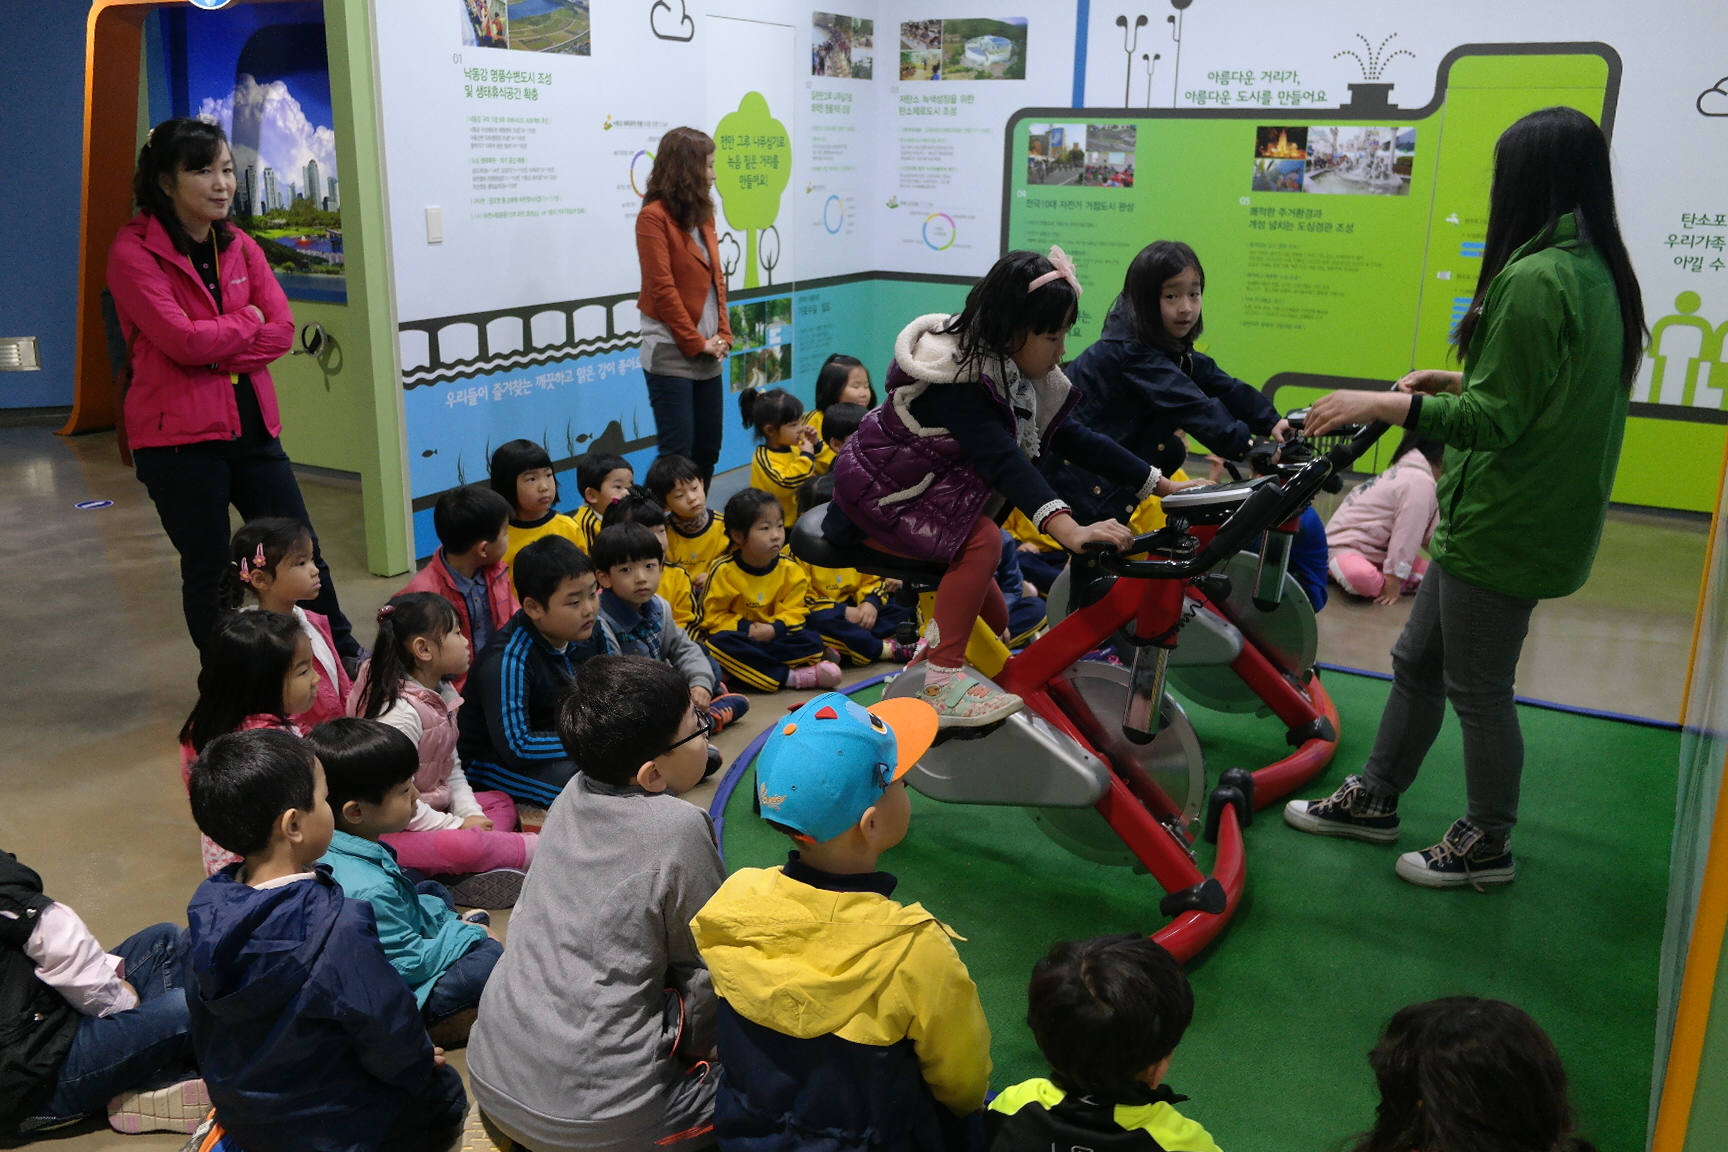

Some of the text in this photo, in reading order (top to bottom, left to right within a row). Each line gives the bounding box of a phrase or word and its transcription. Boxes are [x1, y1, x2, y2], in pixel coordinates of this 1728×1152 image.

[452, 53, 463, 65] 01
[463, 67, 553, 86] 낙동강 명품수변도시 조성
[1207, 70, 1301, 86] 아름다운 거리가,
[464, 84, 539, 102] 및 생태휴식공간 확충
[1184, 90, 1328, 106] 아름다운 도시를 만들어요
[943, 106, 957, 117] 조성
[720, 135, 785, 150] 천만 그루 나무심기로
[727, 154, 779, 170] 녹음 짙은 거리를
[738, 174, 768, 190] 만들어요!
[1016, 190, 1027, 198] 04
[1059, 201, 1083, 210] 자전거
[1085, 201, 1116, 212] 거점도시
[1278, 207, 1322, 219] 주거환경과
[1336, 223, 1354, 234] 조성
[1664, 233, 1726, 252] 우리가족
[1673, 255, 1726, 273] 아낄 수
[445, 385, 489, 409] 우리들이
[492, 377, 534, 401] 즐겨찾는
[535, 369, 574, 391] 깨끗하고
[576, 365, 596, 385] 맑은
[597, 361, 616, 380] 강이
